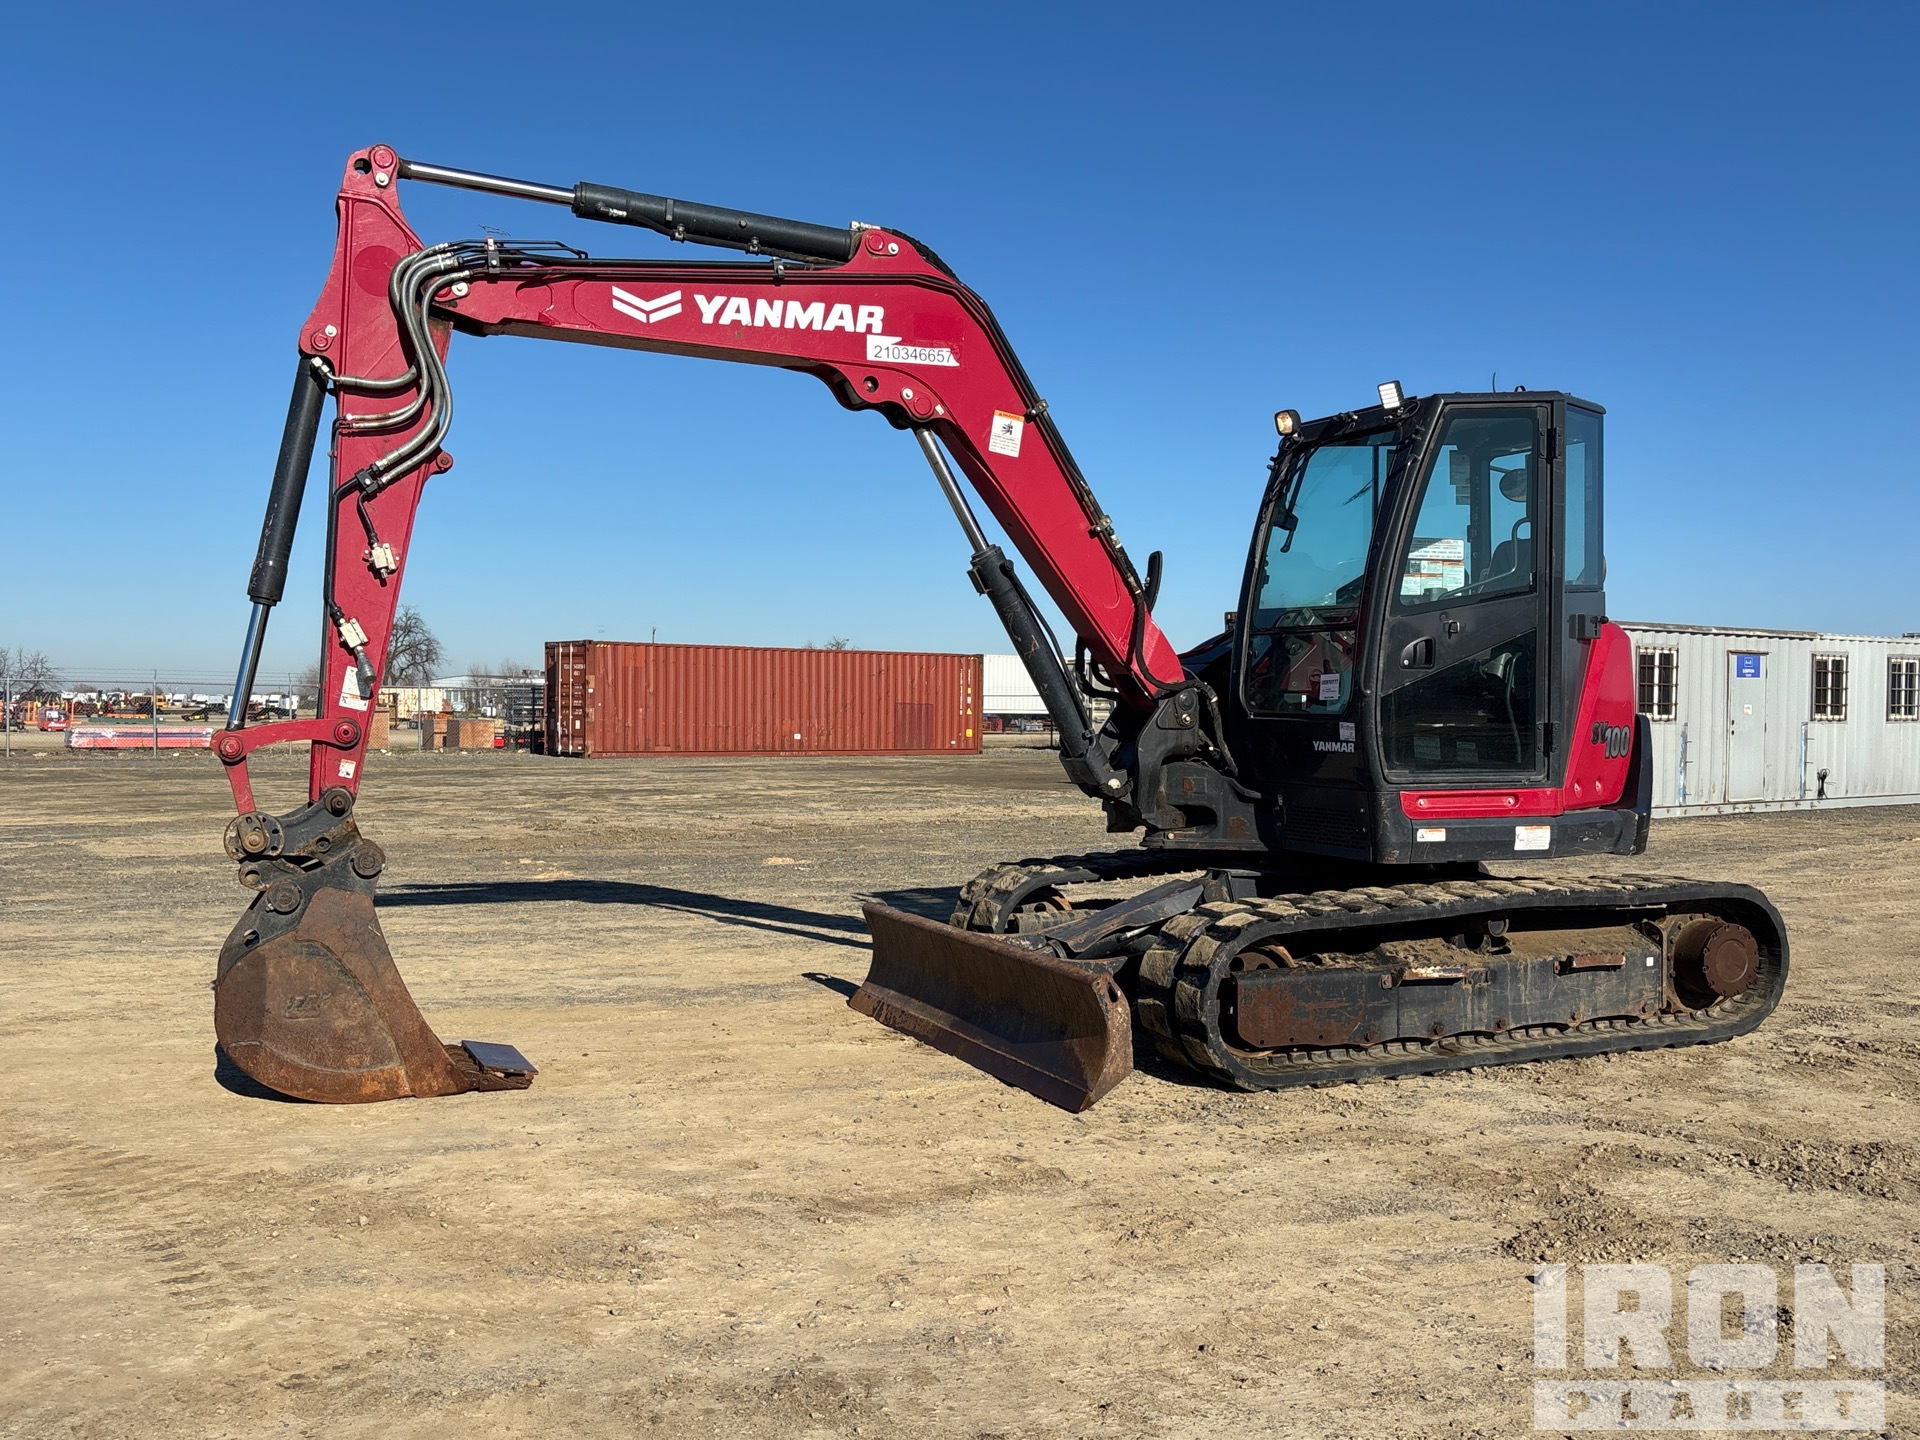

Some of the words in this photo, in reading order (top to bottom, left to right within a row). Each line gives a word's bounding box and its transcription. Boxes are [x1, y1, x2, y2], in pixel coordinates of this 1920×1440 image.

[694, 294, 885, 333] YANMAR
[874, 345, 952, 364] 210346657
[1312, 740, 1355, 753] YANMAR
